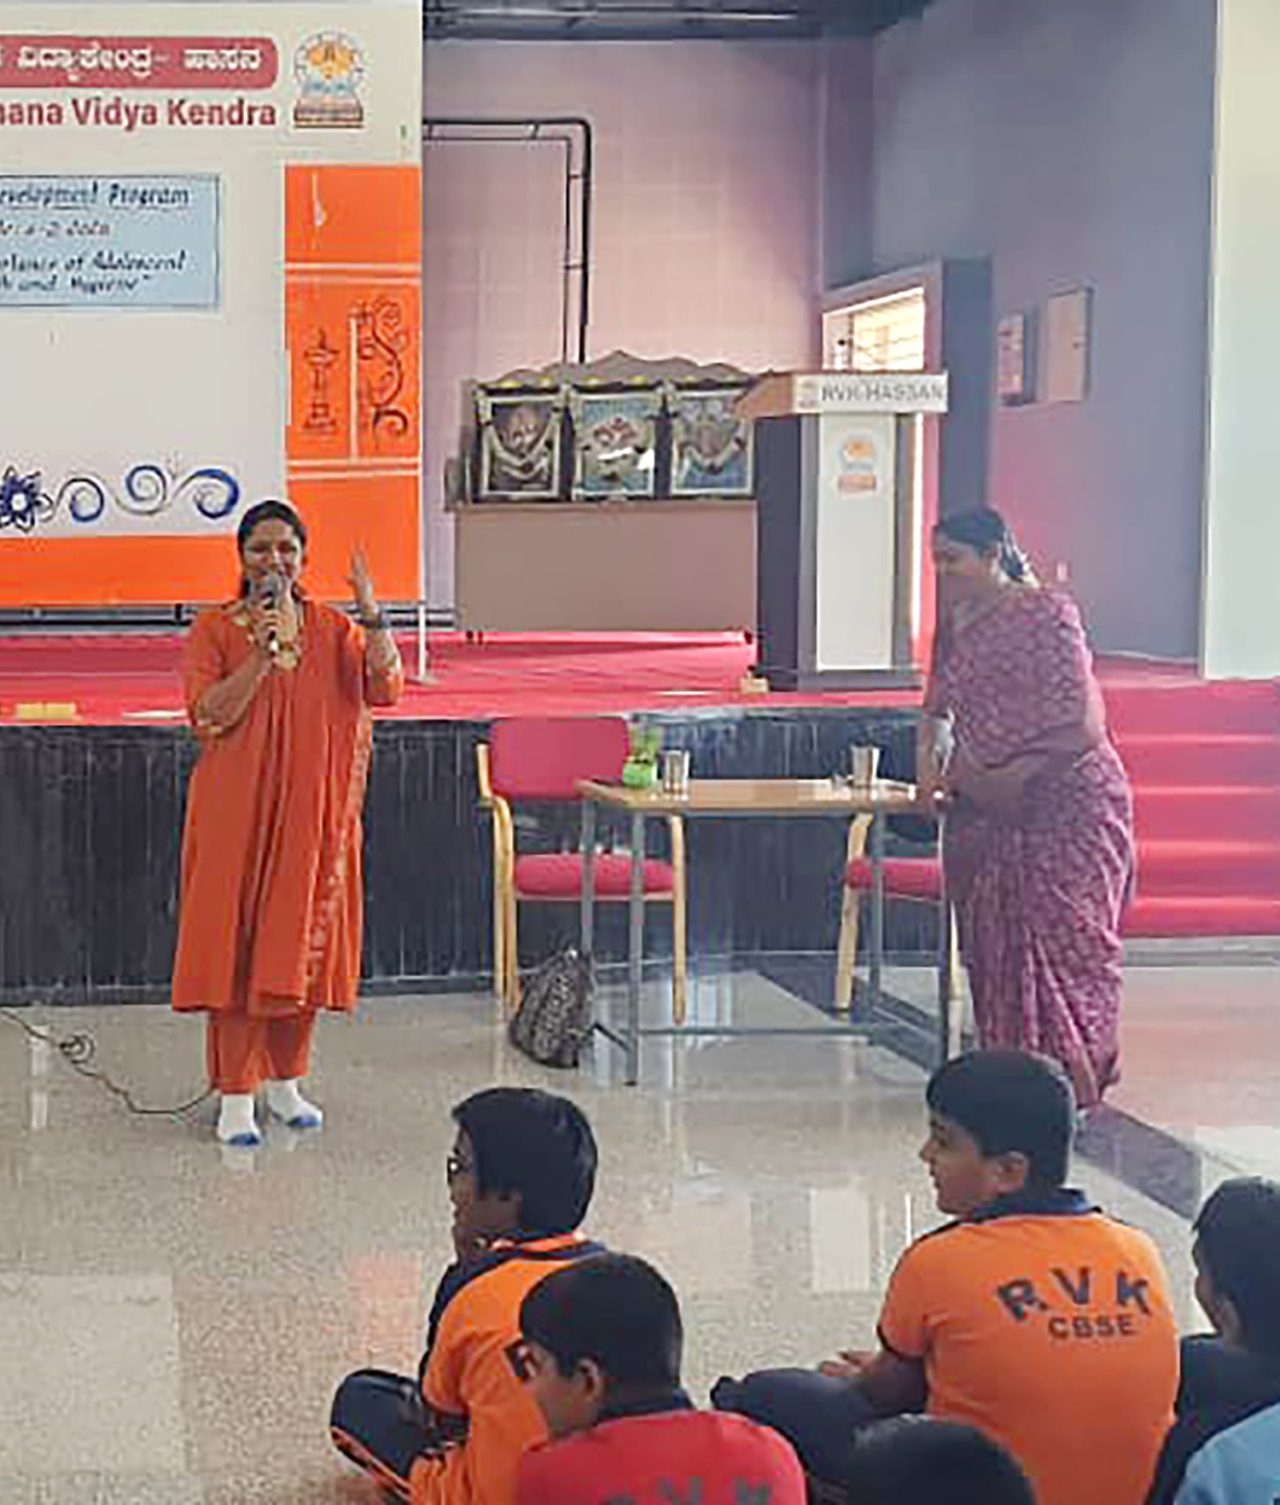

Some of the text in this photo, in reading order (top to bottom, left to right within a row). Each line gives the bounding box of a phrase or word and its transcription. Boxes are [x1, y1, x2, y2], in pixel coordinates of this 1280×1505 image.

[71, 96, 158, 132] Vidya
[168, 96, 276, 126] Kendra
[108, 183, 190, 205] Program
[1048, 1313, 1137, 1339] CBSE
